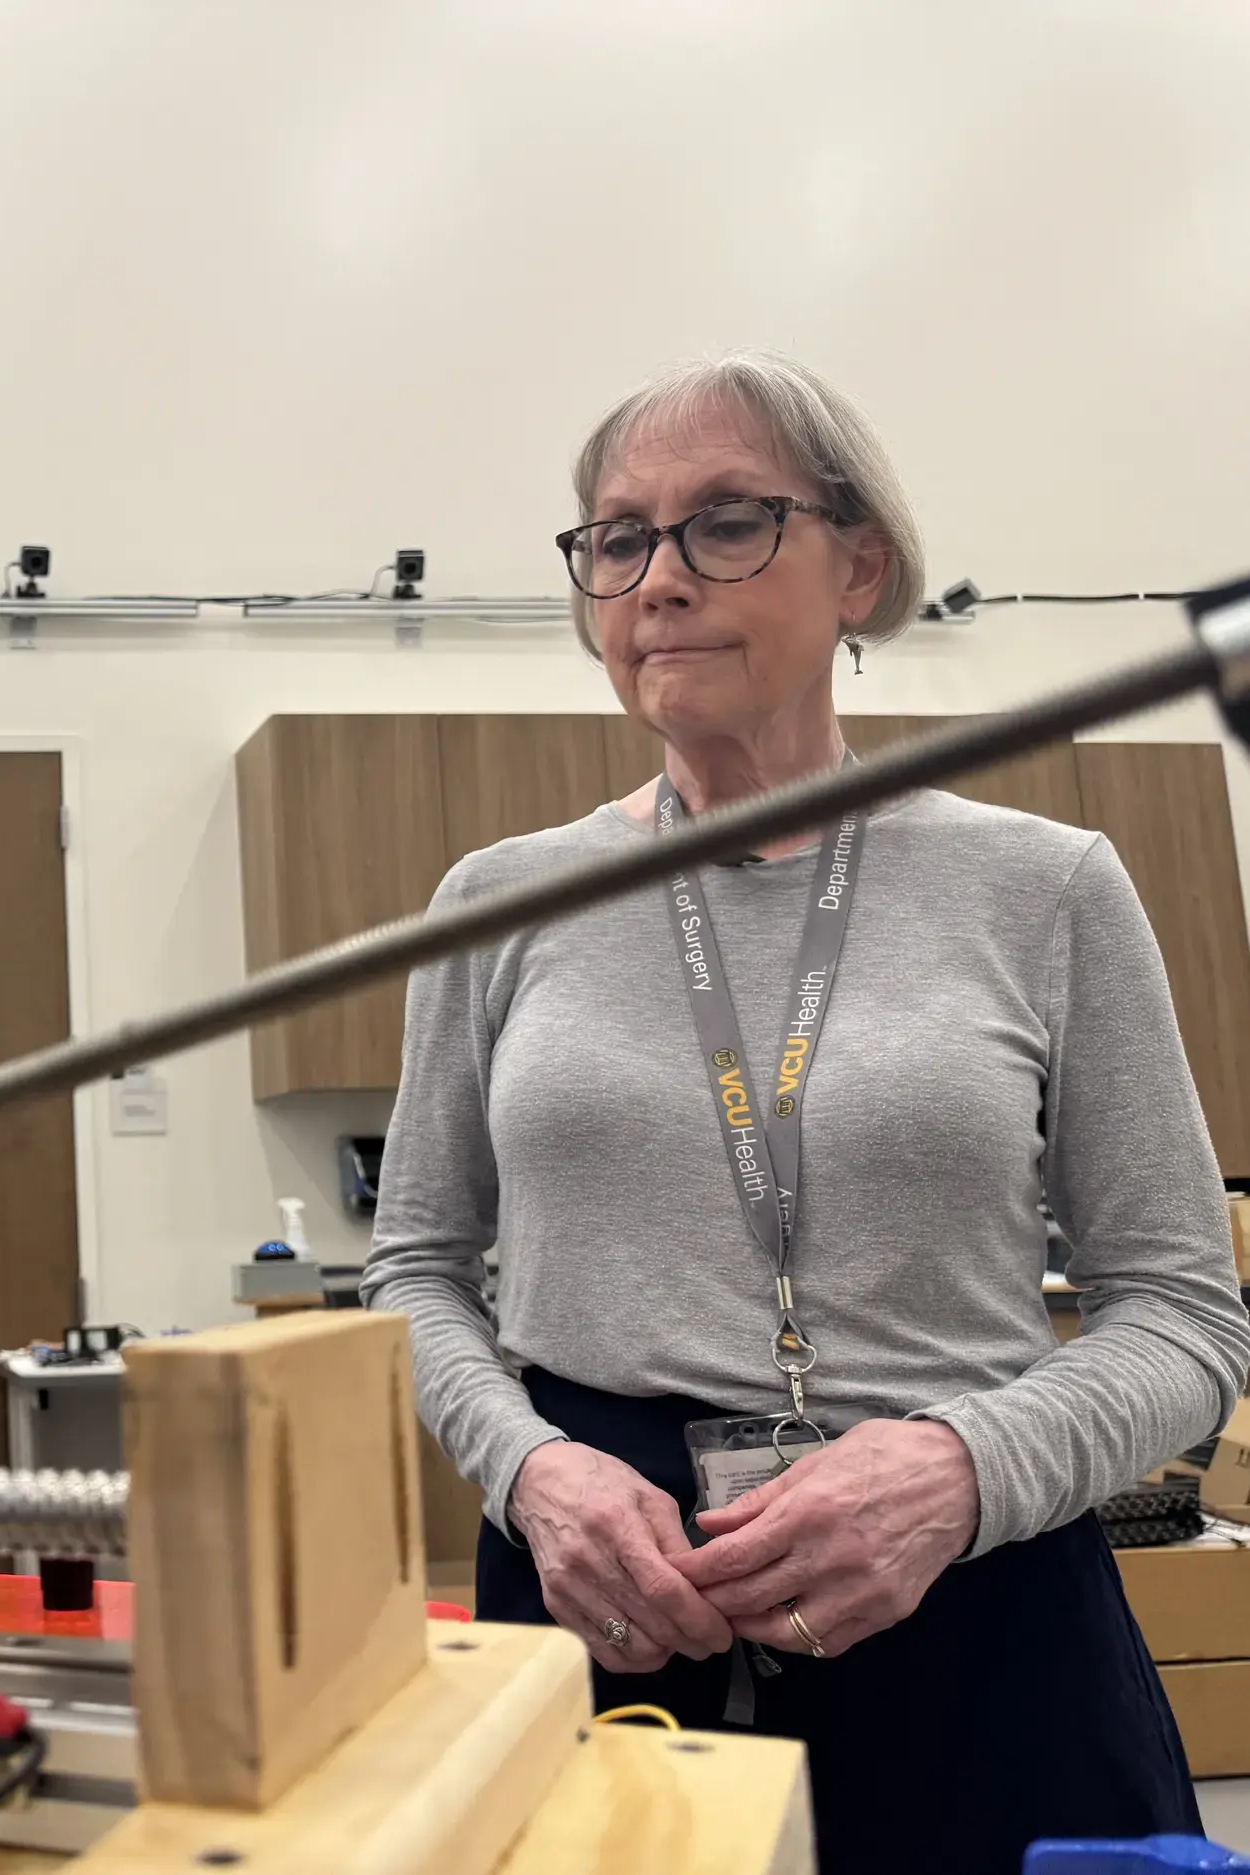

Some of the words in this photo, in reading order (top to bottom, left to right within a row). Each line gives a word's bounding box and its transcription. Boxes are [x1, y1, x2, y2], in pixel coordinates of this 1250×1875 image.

[818, 811, 858, 910] Departmen
[675, 895, 698, 913] of
[681, 916, 713, 991] Surgery
